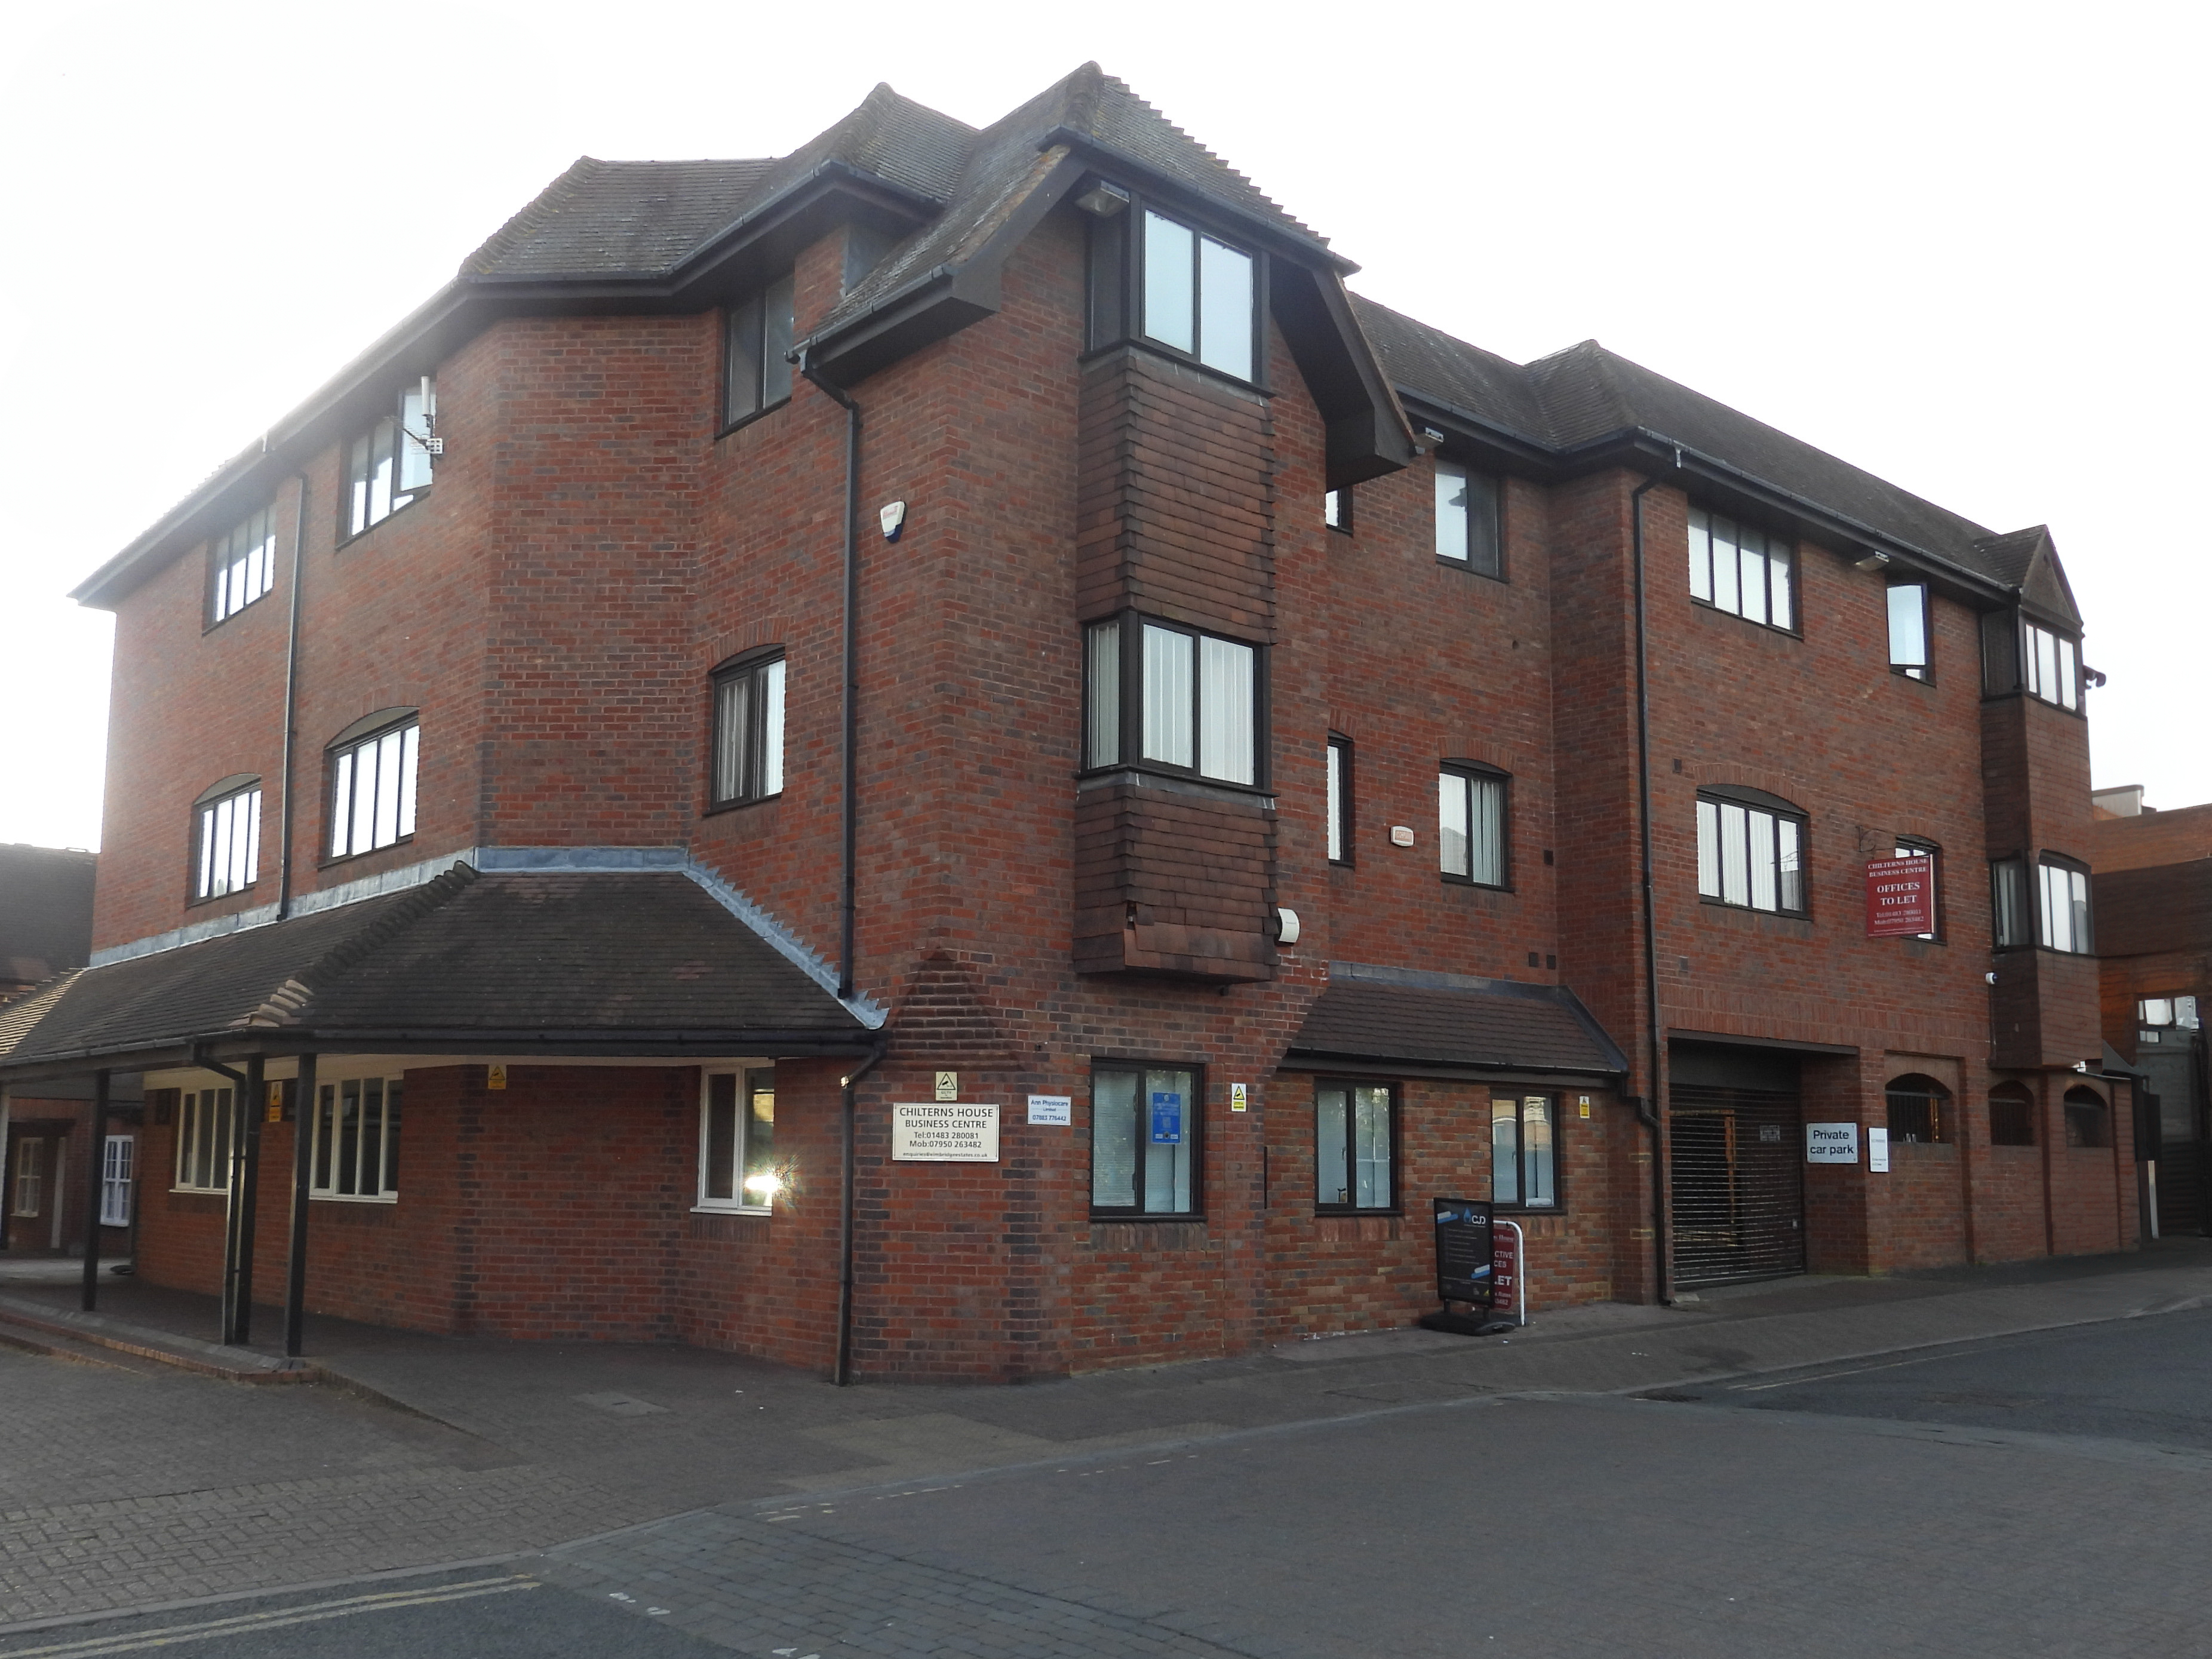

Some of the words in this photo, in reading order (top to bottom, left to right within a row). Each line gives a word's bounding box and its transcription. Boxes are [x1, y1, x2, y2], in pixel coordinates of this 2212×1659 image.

[1877, 881, 1920, 893] OFFICES
[1880, 897, 1894, 906] TO
[1897, 895, 1917, 904] LET
[899, 1107, 954, 1117] CHILTERNS
[957, 1108, 993, 1117] HOUSE
[905, 1120, 949, 1128] BUSINESS
[952, 1120, 987, 1129] CENTRE
[1813, 1130, 1849, 1140] Private
[1809, 1146, 1826, 1154] car
[1830, 1144, 1854, 1156] park
[1494, 1251, 1514, 1259] CTIVE
[1494, 1275, 1512, 1286] ET
